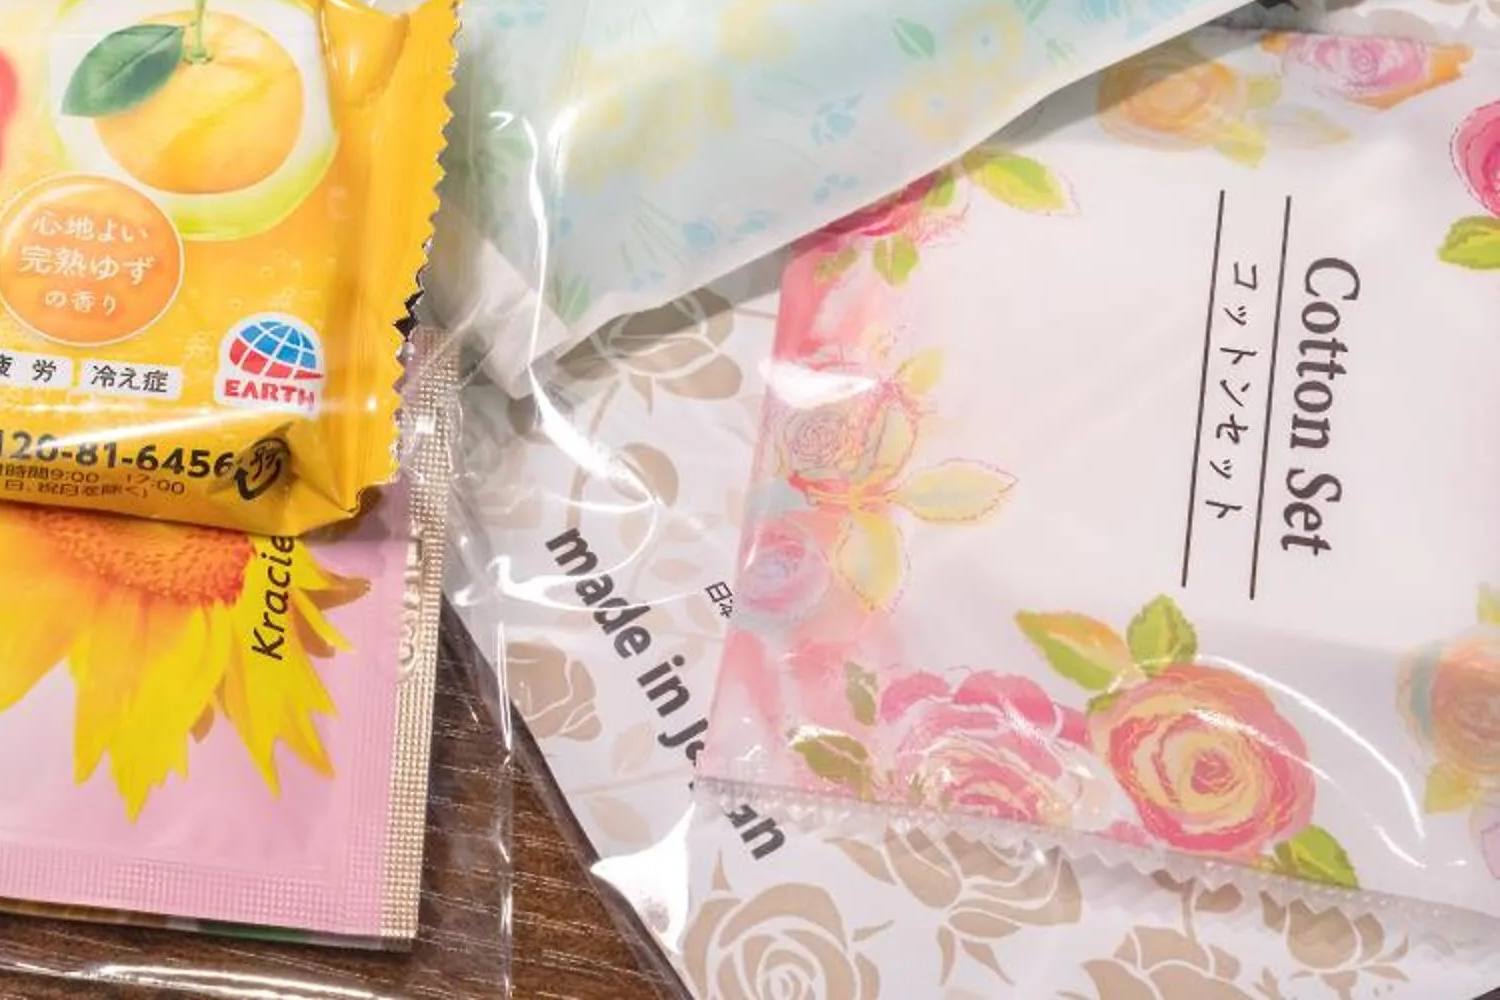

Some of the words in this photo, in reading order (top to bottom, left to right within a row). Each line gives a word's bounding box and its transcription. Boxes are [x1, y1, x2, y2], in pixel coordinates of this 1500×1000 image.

[32, 213, 148, 245] 心地よい
[19, 245, 155, 287] 完熟ゆず
[44, 289, 117, 316] の香り
[90, 364, 169, 393] 冷え症
[1289, 257, 1361, 452] Cotton
[224, 377, 316, 410] EARTH
[1205, 261, 1258, 520] コットンセット
[1280, 467, 1344, 557] Set
[251, 535, 296, 661] Kracie
[545, 526, 653, 660] made
[637, 654, 691, 718] in
